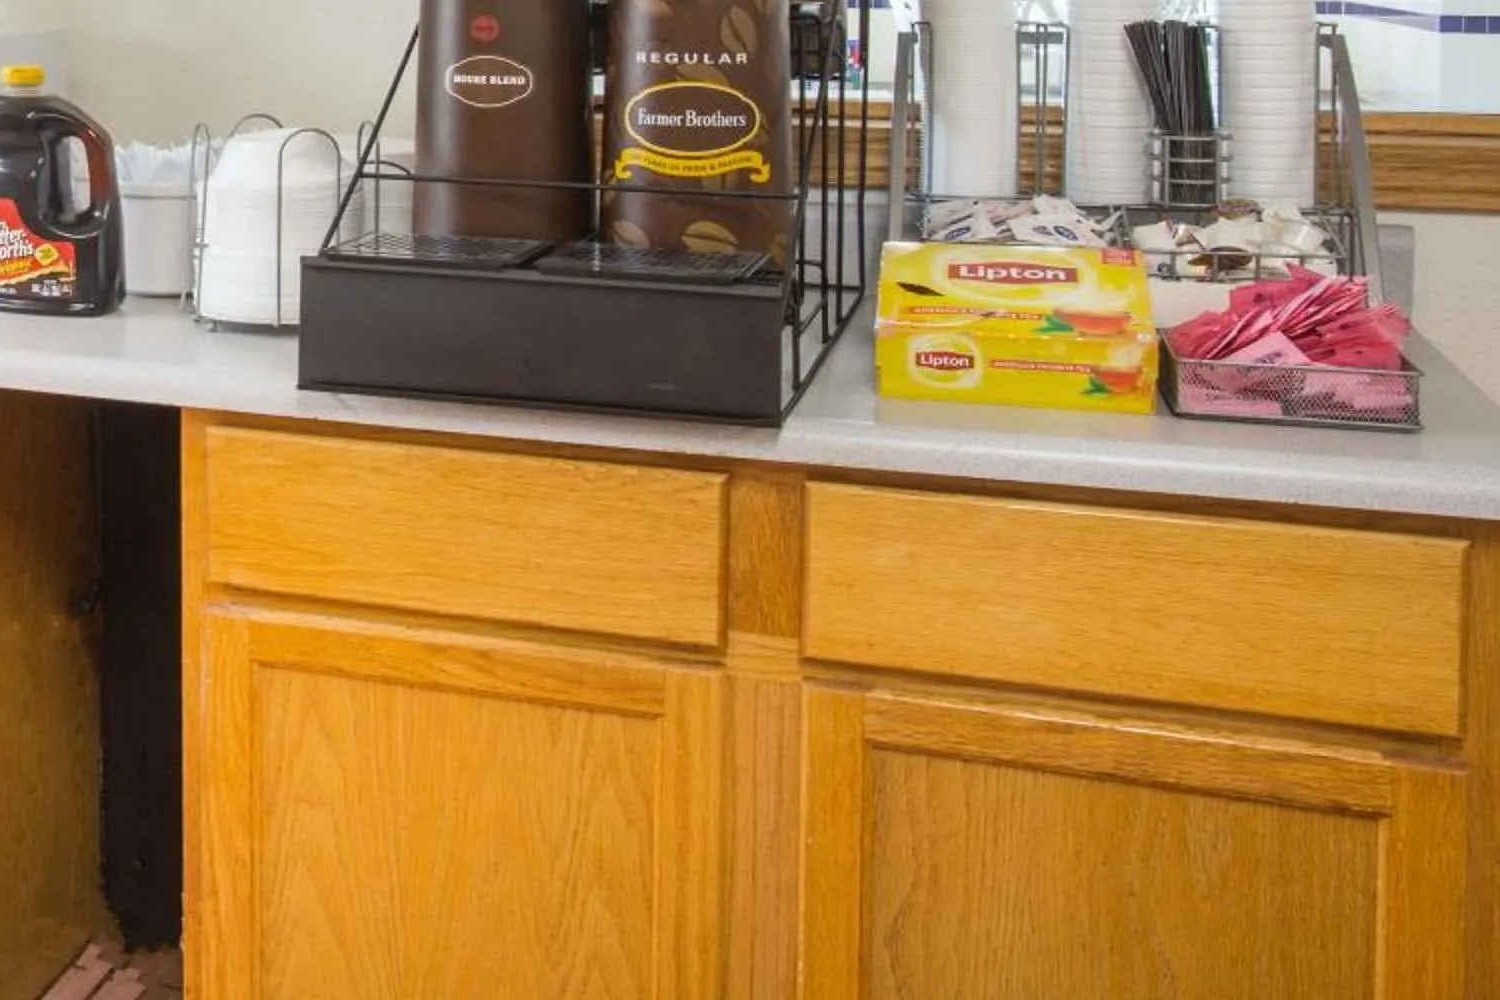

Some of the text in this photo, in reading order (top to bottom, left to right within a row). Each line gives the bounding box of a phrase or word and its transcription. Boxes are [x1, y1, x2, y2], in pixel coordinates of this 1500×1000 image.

[636, 51, 749, 65] REGULAR
[637, 107, 748, 127] Farmer Brothers
[958, 264, 1067, 282] Lipton
[919, 354, 971, 369] Lipton
